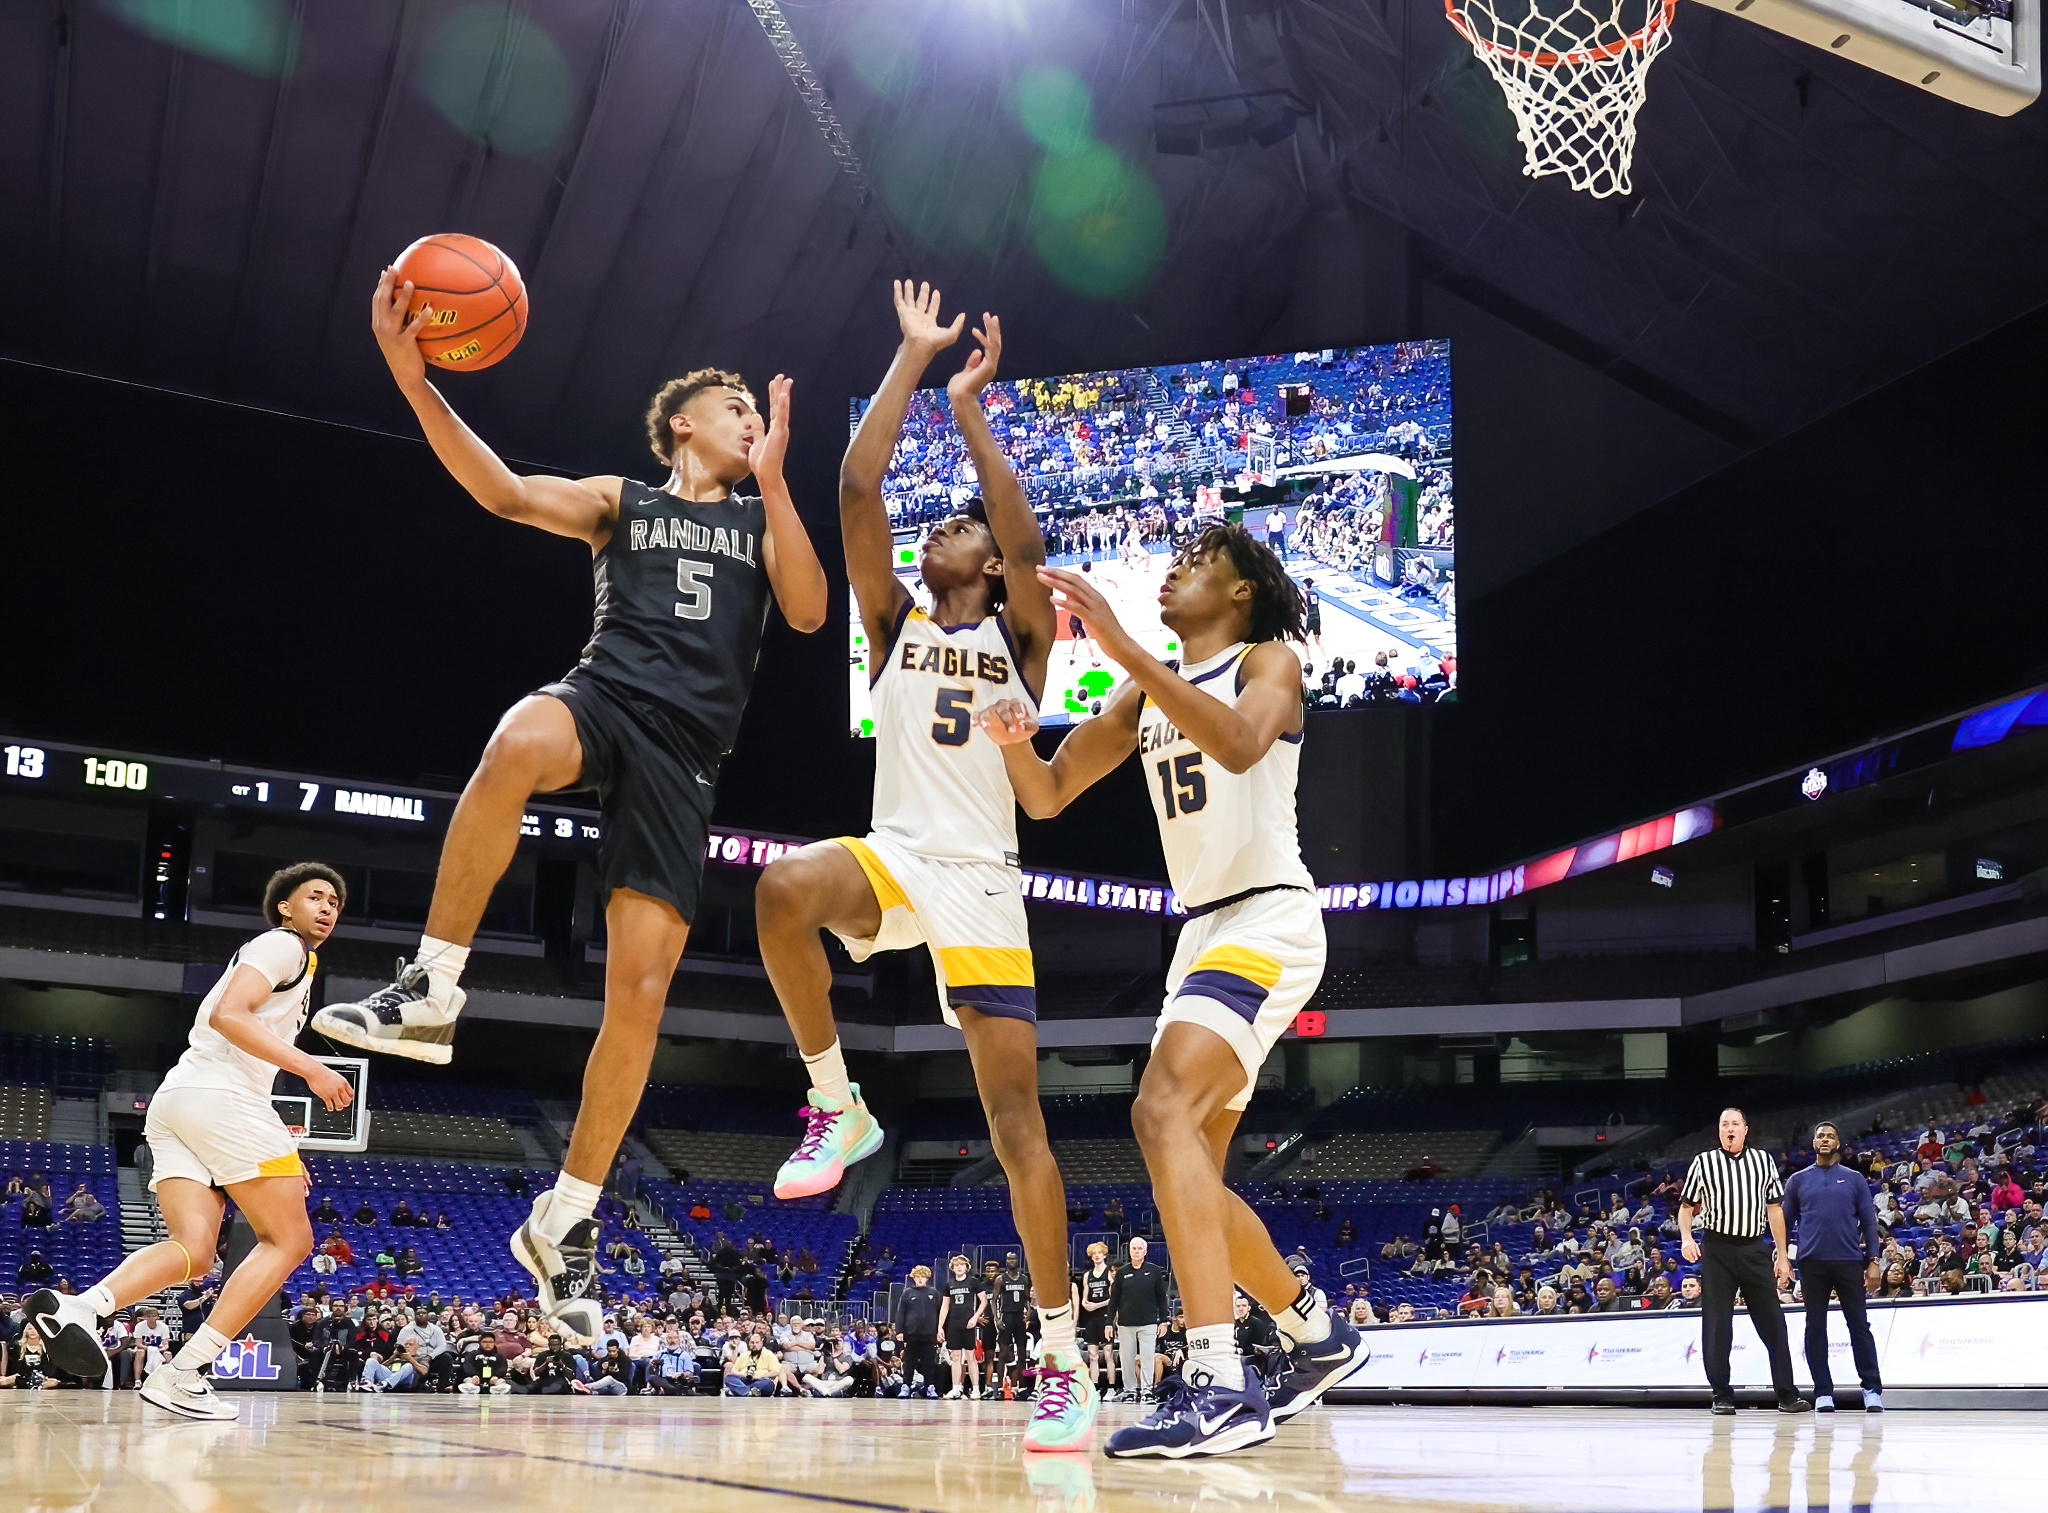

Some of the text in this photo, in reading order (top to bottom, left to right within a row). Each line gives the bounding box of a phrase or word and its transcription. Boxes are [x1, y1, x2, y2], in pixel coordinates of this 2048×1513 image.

[631, 518, 756, 568] RANDALL
[675, 558, 713, 620] 5
[901, 643, 1009, 684] EAGLES
[932, 687, 973, 746] 5
[1140, 721, 1185, 755] EAG
[4, 745, 45, 778] 13
[84, 757, 148, 790] 1:00
[255, 782, 269, 802] 1
[299, 782, 319, 811] 7
[334, 789, 425, 822] RANDALL
[1157, 751, 1207, 820] 15
[521, 814, 539, 825] AM
[554, 817, 574, 838] 3
[708, 835, 741, 861] TO
[1021, 874, 1088, 904] TBALL
[1097, 884, 1162, 912] STATE
[1317, 885, 1371, 909] HIPS
[211, 1333, 281, 1380] UIL
